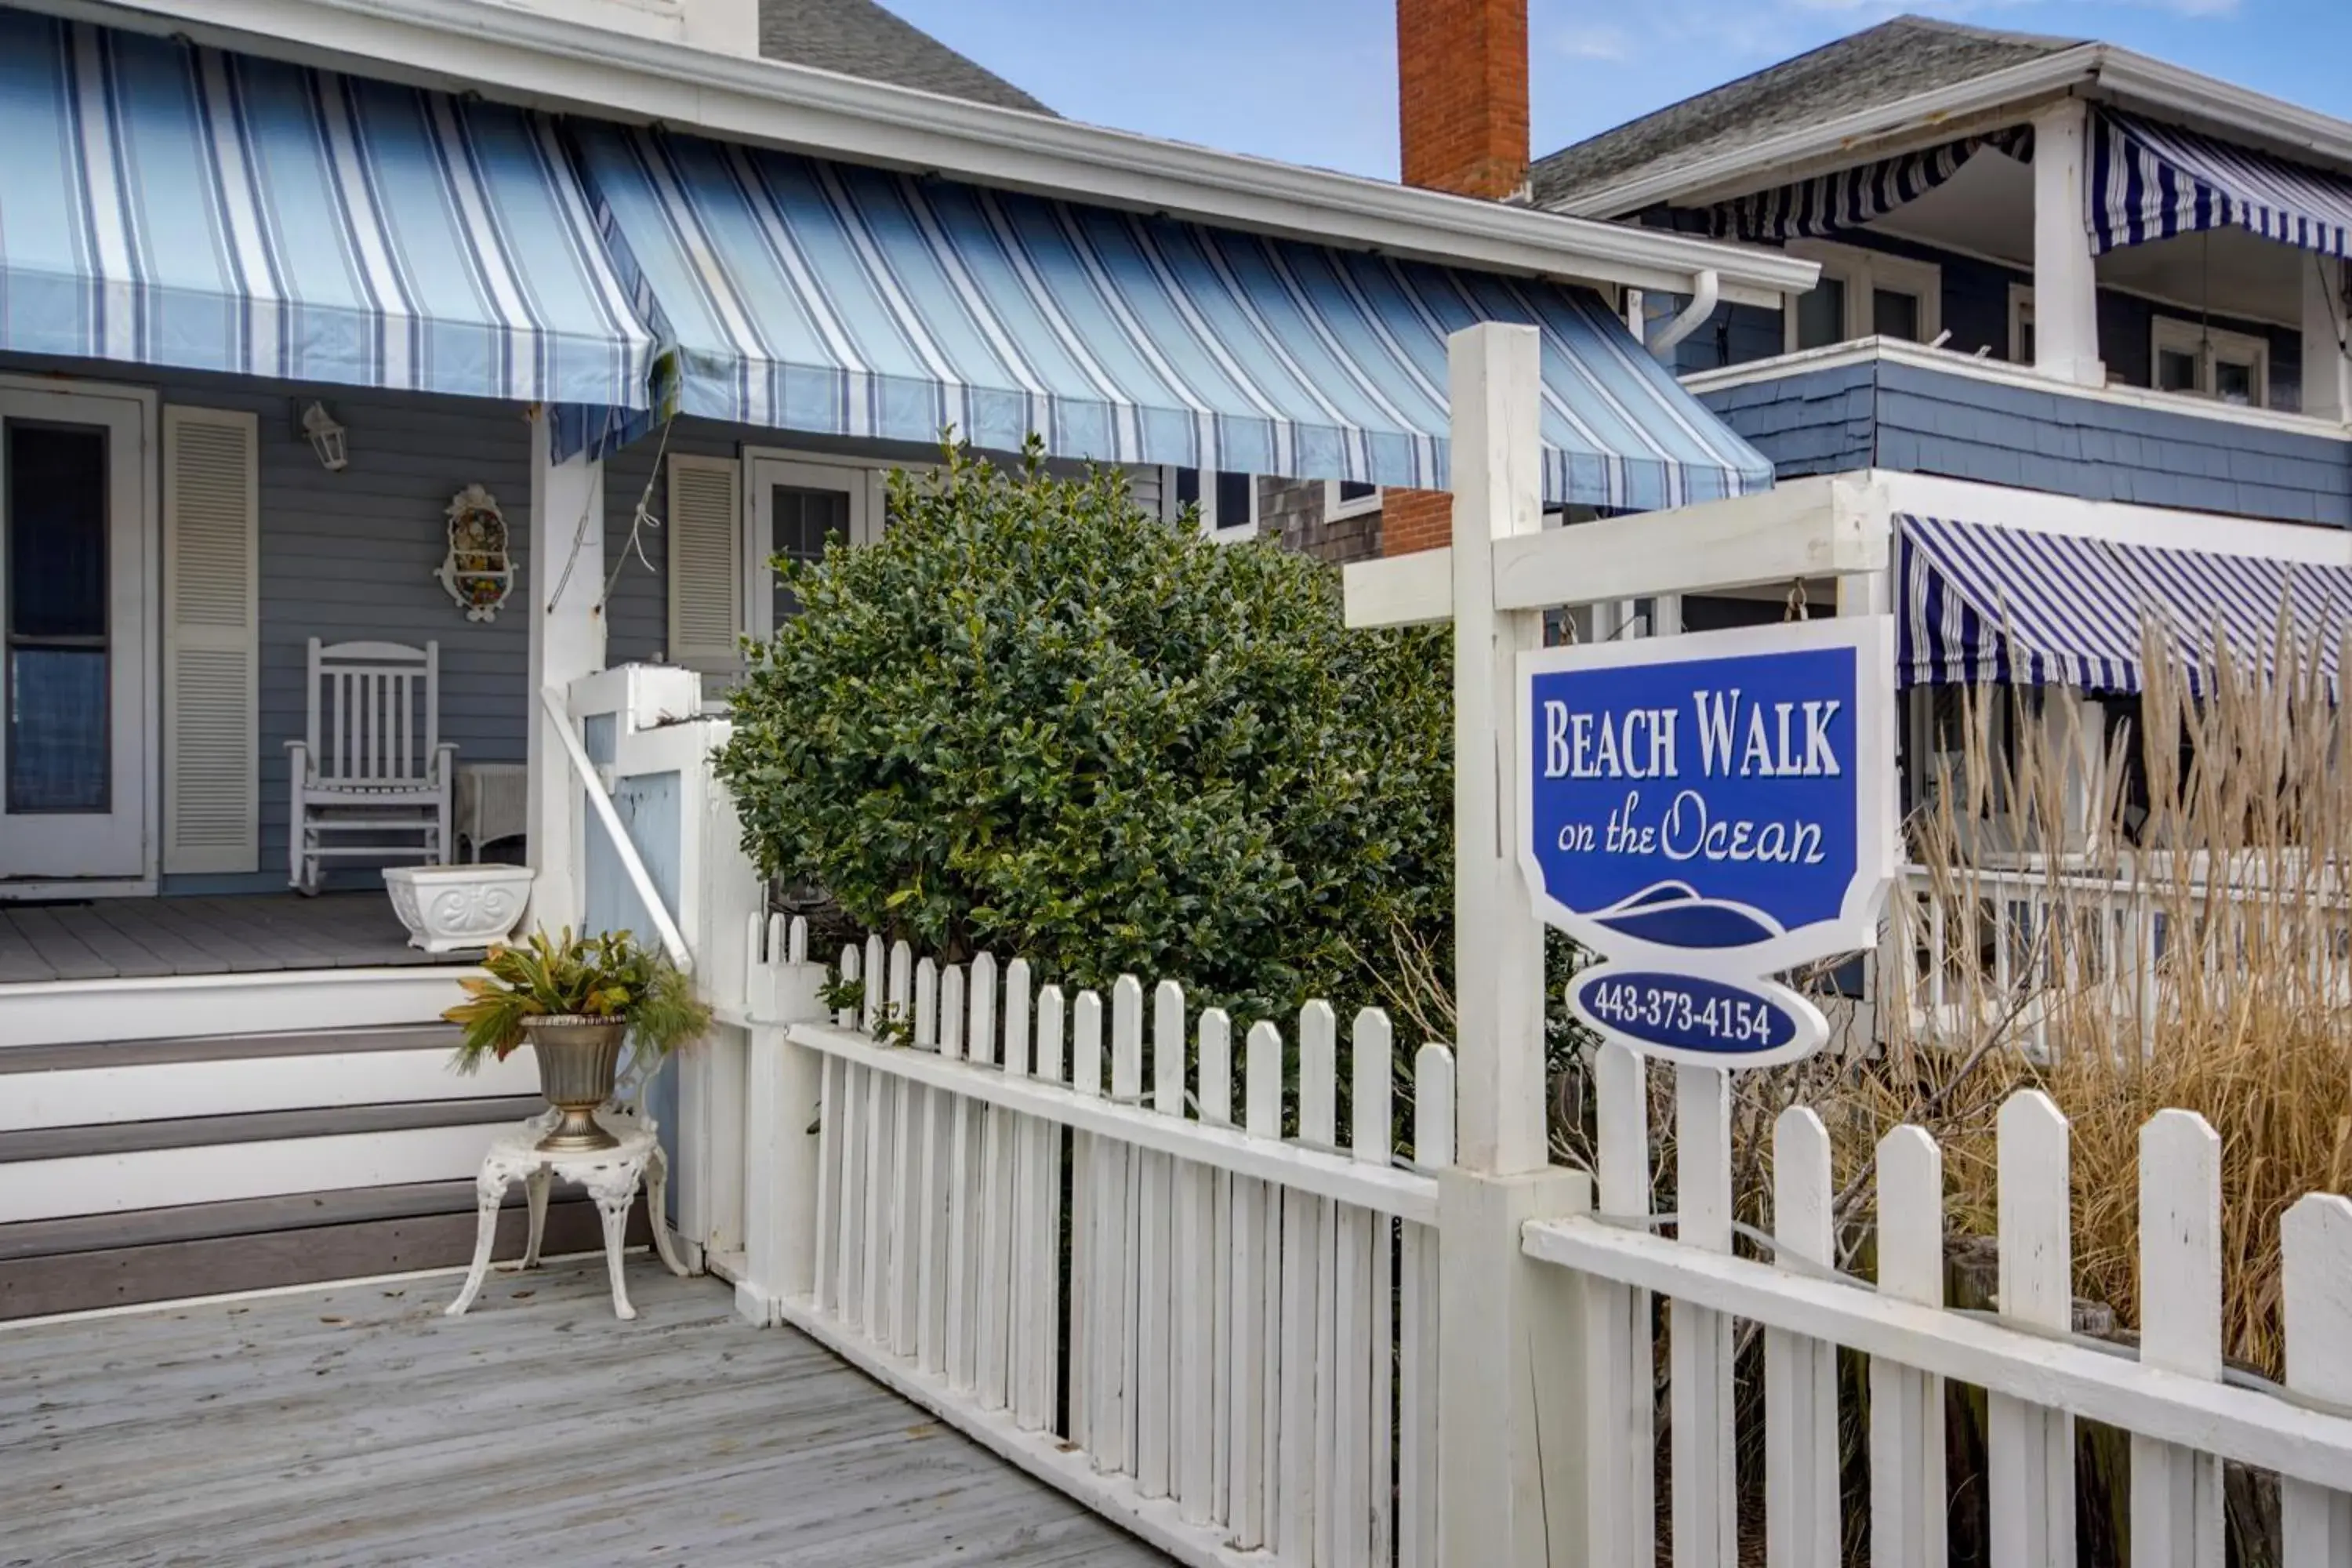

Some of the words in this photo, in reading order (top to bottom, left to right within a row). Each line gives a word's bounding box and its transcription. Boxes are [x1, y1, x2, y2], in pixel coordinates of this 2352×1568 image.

[1544, 700, 1679, 779] BEACH
[1693, 688, 1841, 777] WALK
[1558, 822, 1595, 852] on
[1606, 789, 1657, 855] the
[1661, 789, 1825, 864] Ocean
[1595, 982, 1772, 1045] 443-373-4154
